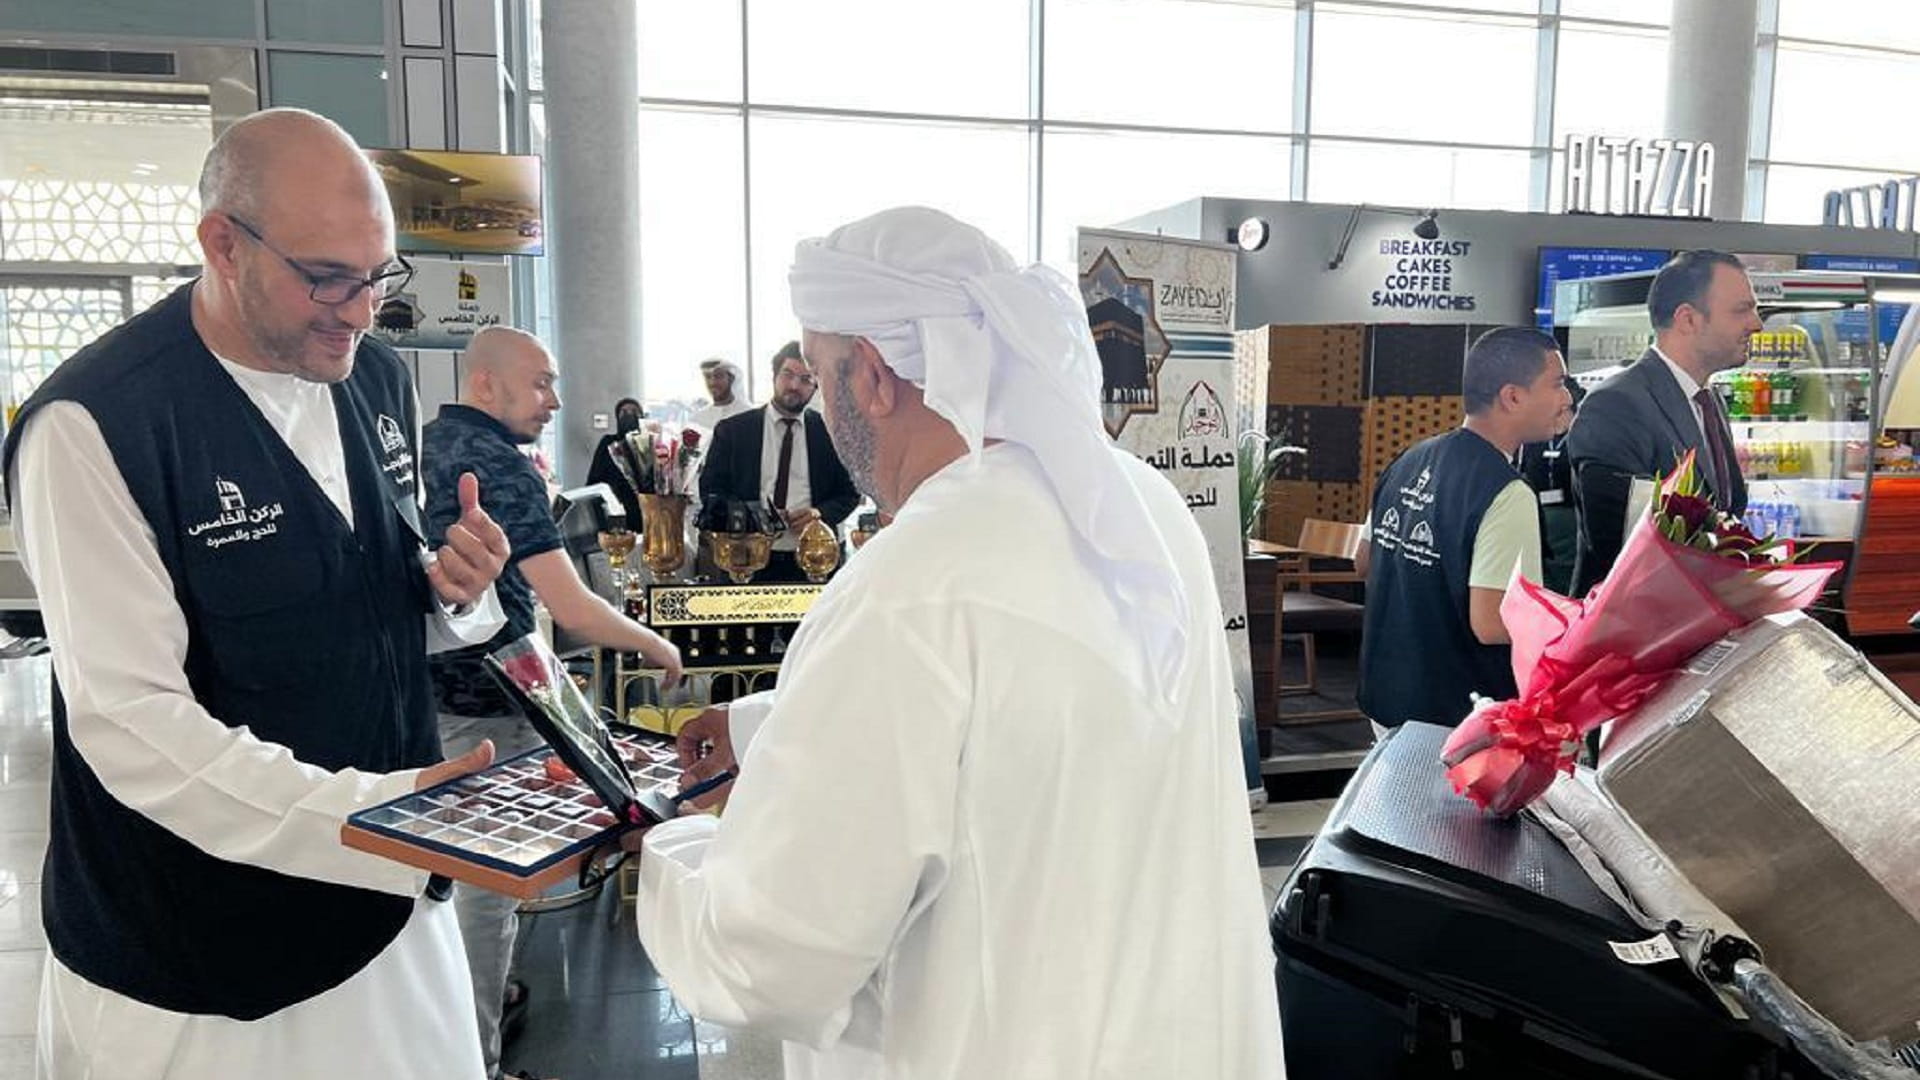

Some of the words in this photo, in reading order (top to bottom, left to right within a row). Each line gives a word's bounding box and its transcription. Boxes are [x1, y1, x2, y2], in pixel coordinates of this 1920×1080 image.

[1379, 240, 1471, 256] BREAKFAST
[1396, 258, 1452, 274] CAKES
[1385, 275, 1451, 291] COFFEE
[1371, 291, 1476, 310] SANDWICHES
[248, 502, 284, 523] الركن
[187, 509, 247, 536] الخامس
[251, 522, 278, 540] للحج
